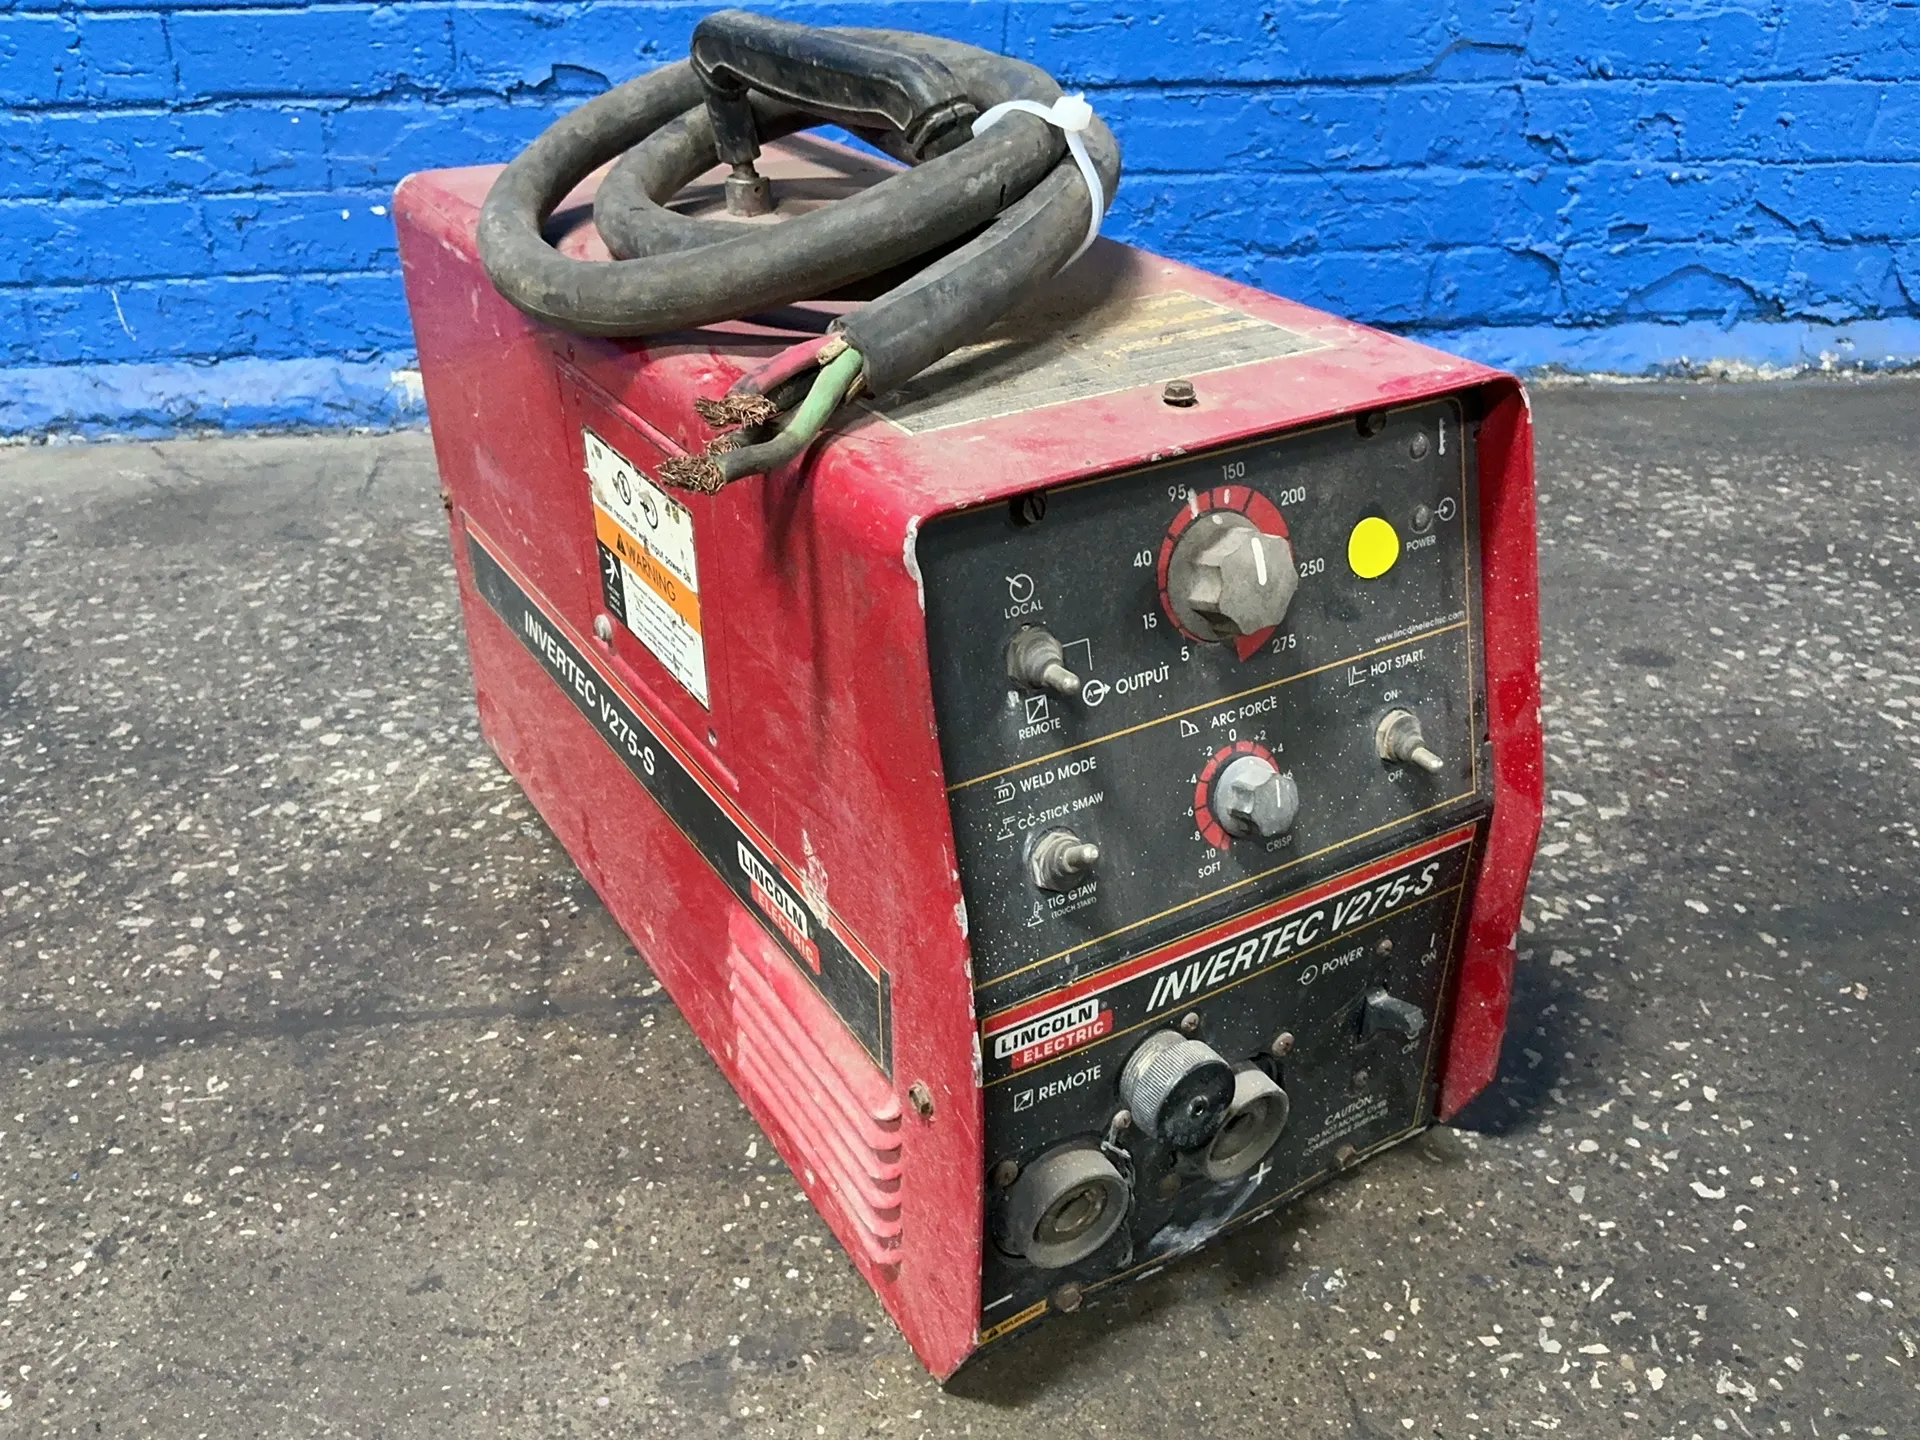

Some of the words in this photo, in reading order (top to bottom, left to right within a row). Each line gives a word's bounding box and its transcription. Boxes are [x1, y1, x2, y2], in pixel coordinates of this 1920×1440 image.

[1222, 462, 1245, 480] 150
[1168, 484, 1186, 501] 95
[1280, 486, 1306, 506] 200
[1405, 534, 1437, 552] POWER
[1133, 550, 1152, 568] 40
[1299, 558, 1325, 578] 250
[625, 541, 676, 602] WARNING
[1004, 599, 1044, 620] LOCAL
[1142, 612, 1158, 629] 15
[1180, 646, 1190, 661] 5
[1272, 634, 1297, 654] 275
[1370, 657, 1392, 677] HOT
[1115, 665, 1170, 695] OUTPUT
[524, 610, 597, 708] INVERTEC
[600, 693, 656, 776] V275-S
[1383, 688, 1398, 702] ON
[1211, 710, 1236, 729] ARC
[1240, 696, 1278, 720] FORCE
[1018, 717, 1062, 741] REMOTE
[1229, 729, 1237, 742] 0
[1254, 730, 1266, 742] +2
[1271, 743, 1284, 754] +4
[1020, 771, 1055, 793] WELD
[1058, 756, 1098, 781] MODE
[1186, 773, 1197, 784] -4
[1388, 768, 1404, 783] OFF
[1018, 803, 1070, 831] CC-STICK
[1072, 791, 1105, 812] SMAW
[1182, 806, 1194, 817] -6
[1190, 830, 1201, 841] -8
[1266, 834, 1292, 853] CRISP
[1201, 848, 1216, 860] -10
[1198, 861, 1222, 879] SOFT
[741, 848, 804, 933] LINCOLN
[1047, 894, 1066, 909] TIG
[1068, 881, 1098, 900] GTAW
[757, 889, 814, 964] ELECTRIC
[1145, 910, 1325, 1013] INVERTEC
[1331, 862, 1440, 932] V275-S
[1321, 946, 1364, 975] POWER
[1420, 948, 1437, 966] ON
[1000, 1004, 1093, 1055] LINCOLN
[1023, 1021, 1105, 1064] ELECTRIC
[1038, 1064, 1102, 1101] REMOTE
[1324, 1094, 1374, 1126] CAUTION
